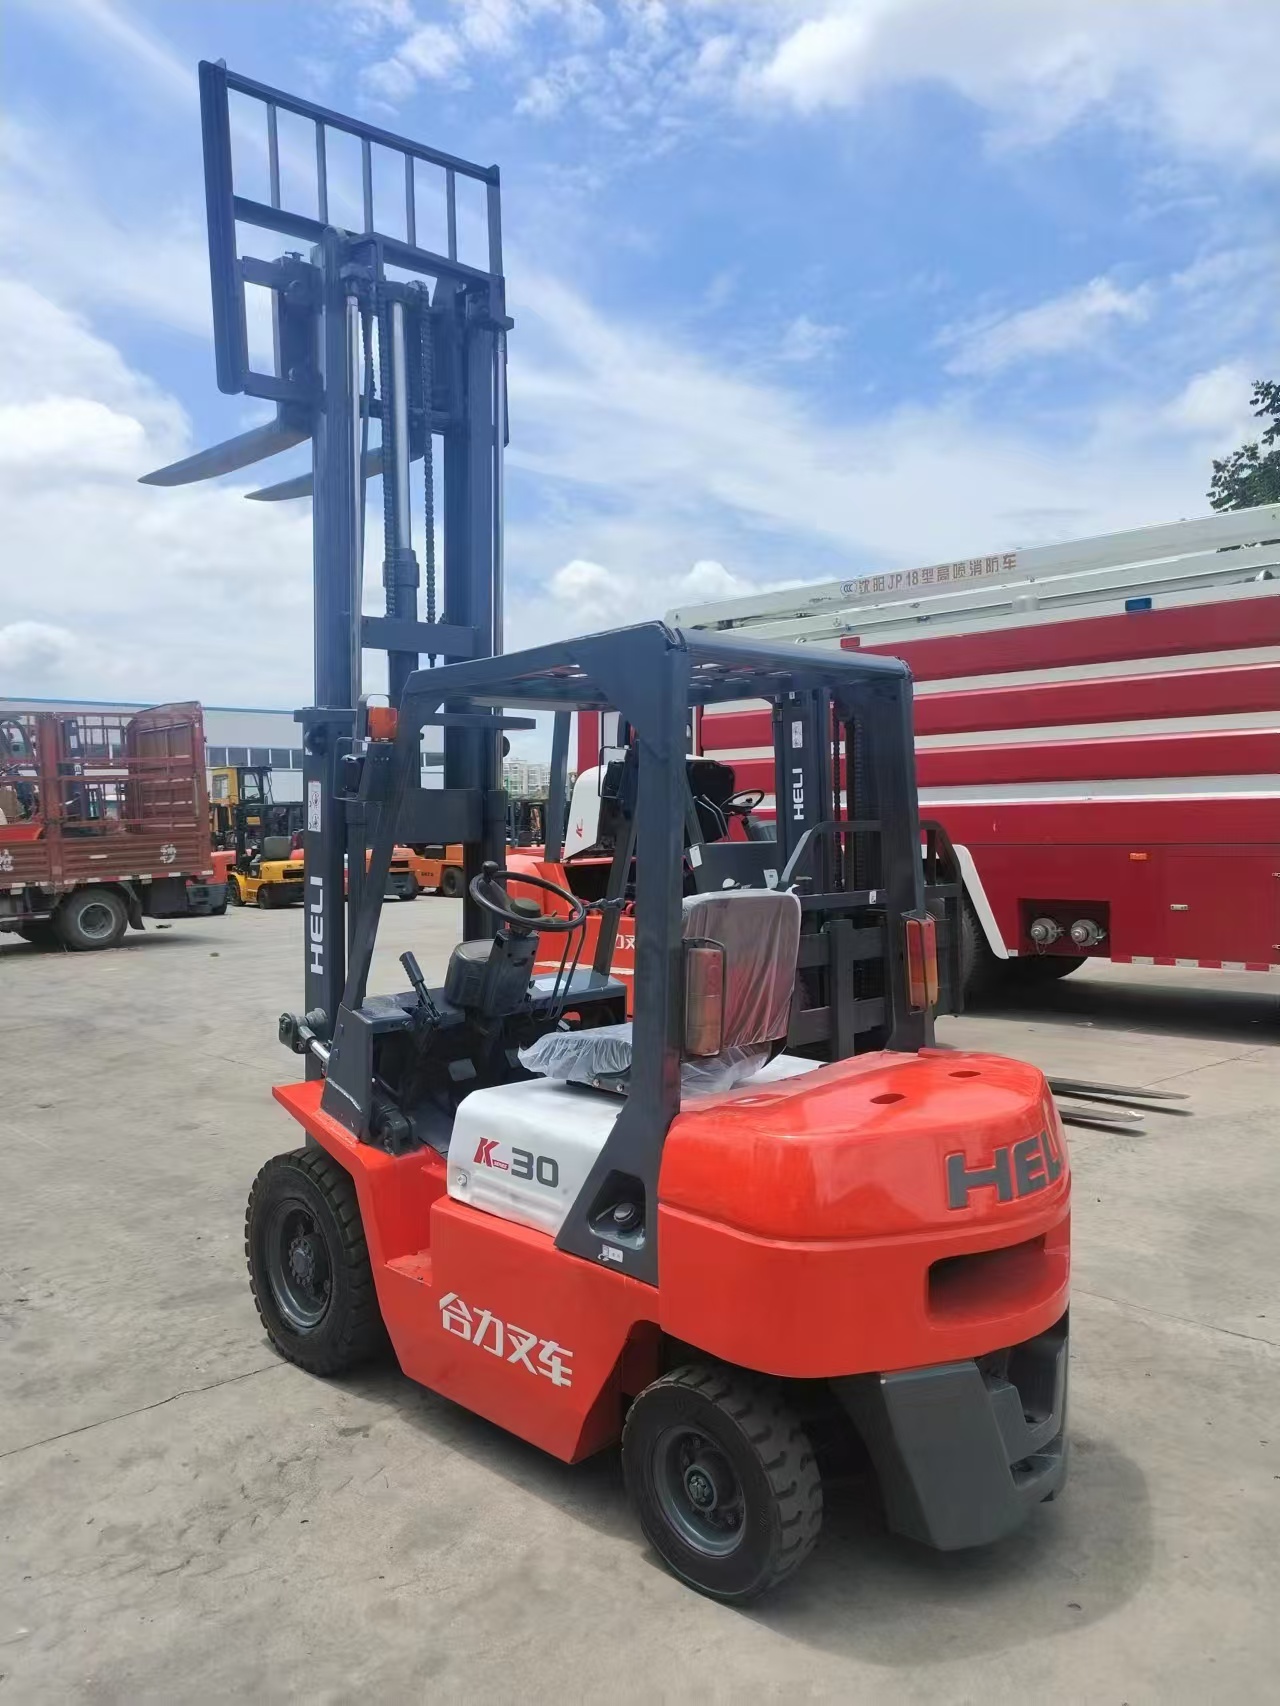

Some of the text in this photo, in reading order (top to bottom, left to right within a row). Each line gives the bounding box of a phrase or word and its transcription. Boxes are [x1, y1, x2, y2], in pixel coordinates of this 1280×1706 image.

[792, 768, 804, 820] HELI
[310, 876, 323, 975] HELI
[473, 1136, 500, 1168] K
[511, 1147, 559, 1188] 30
[439, 1292, 574, 1388] 合力叉车
